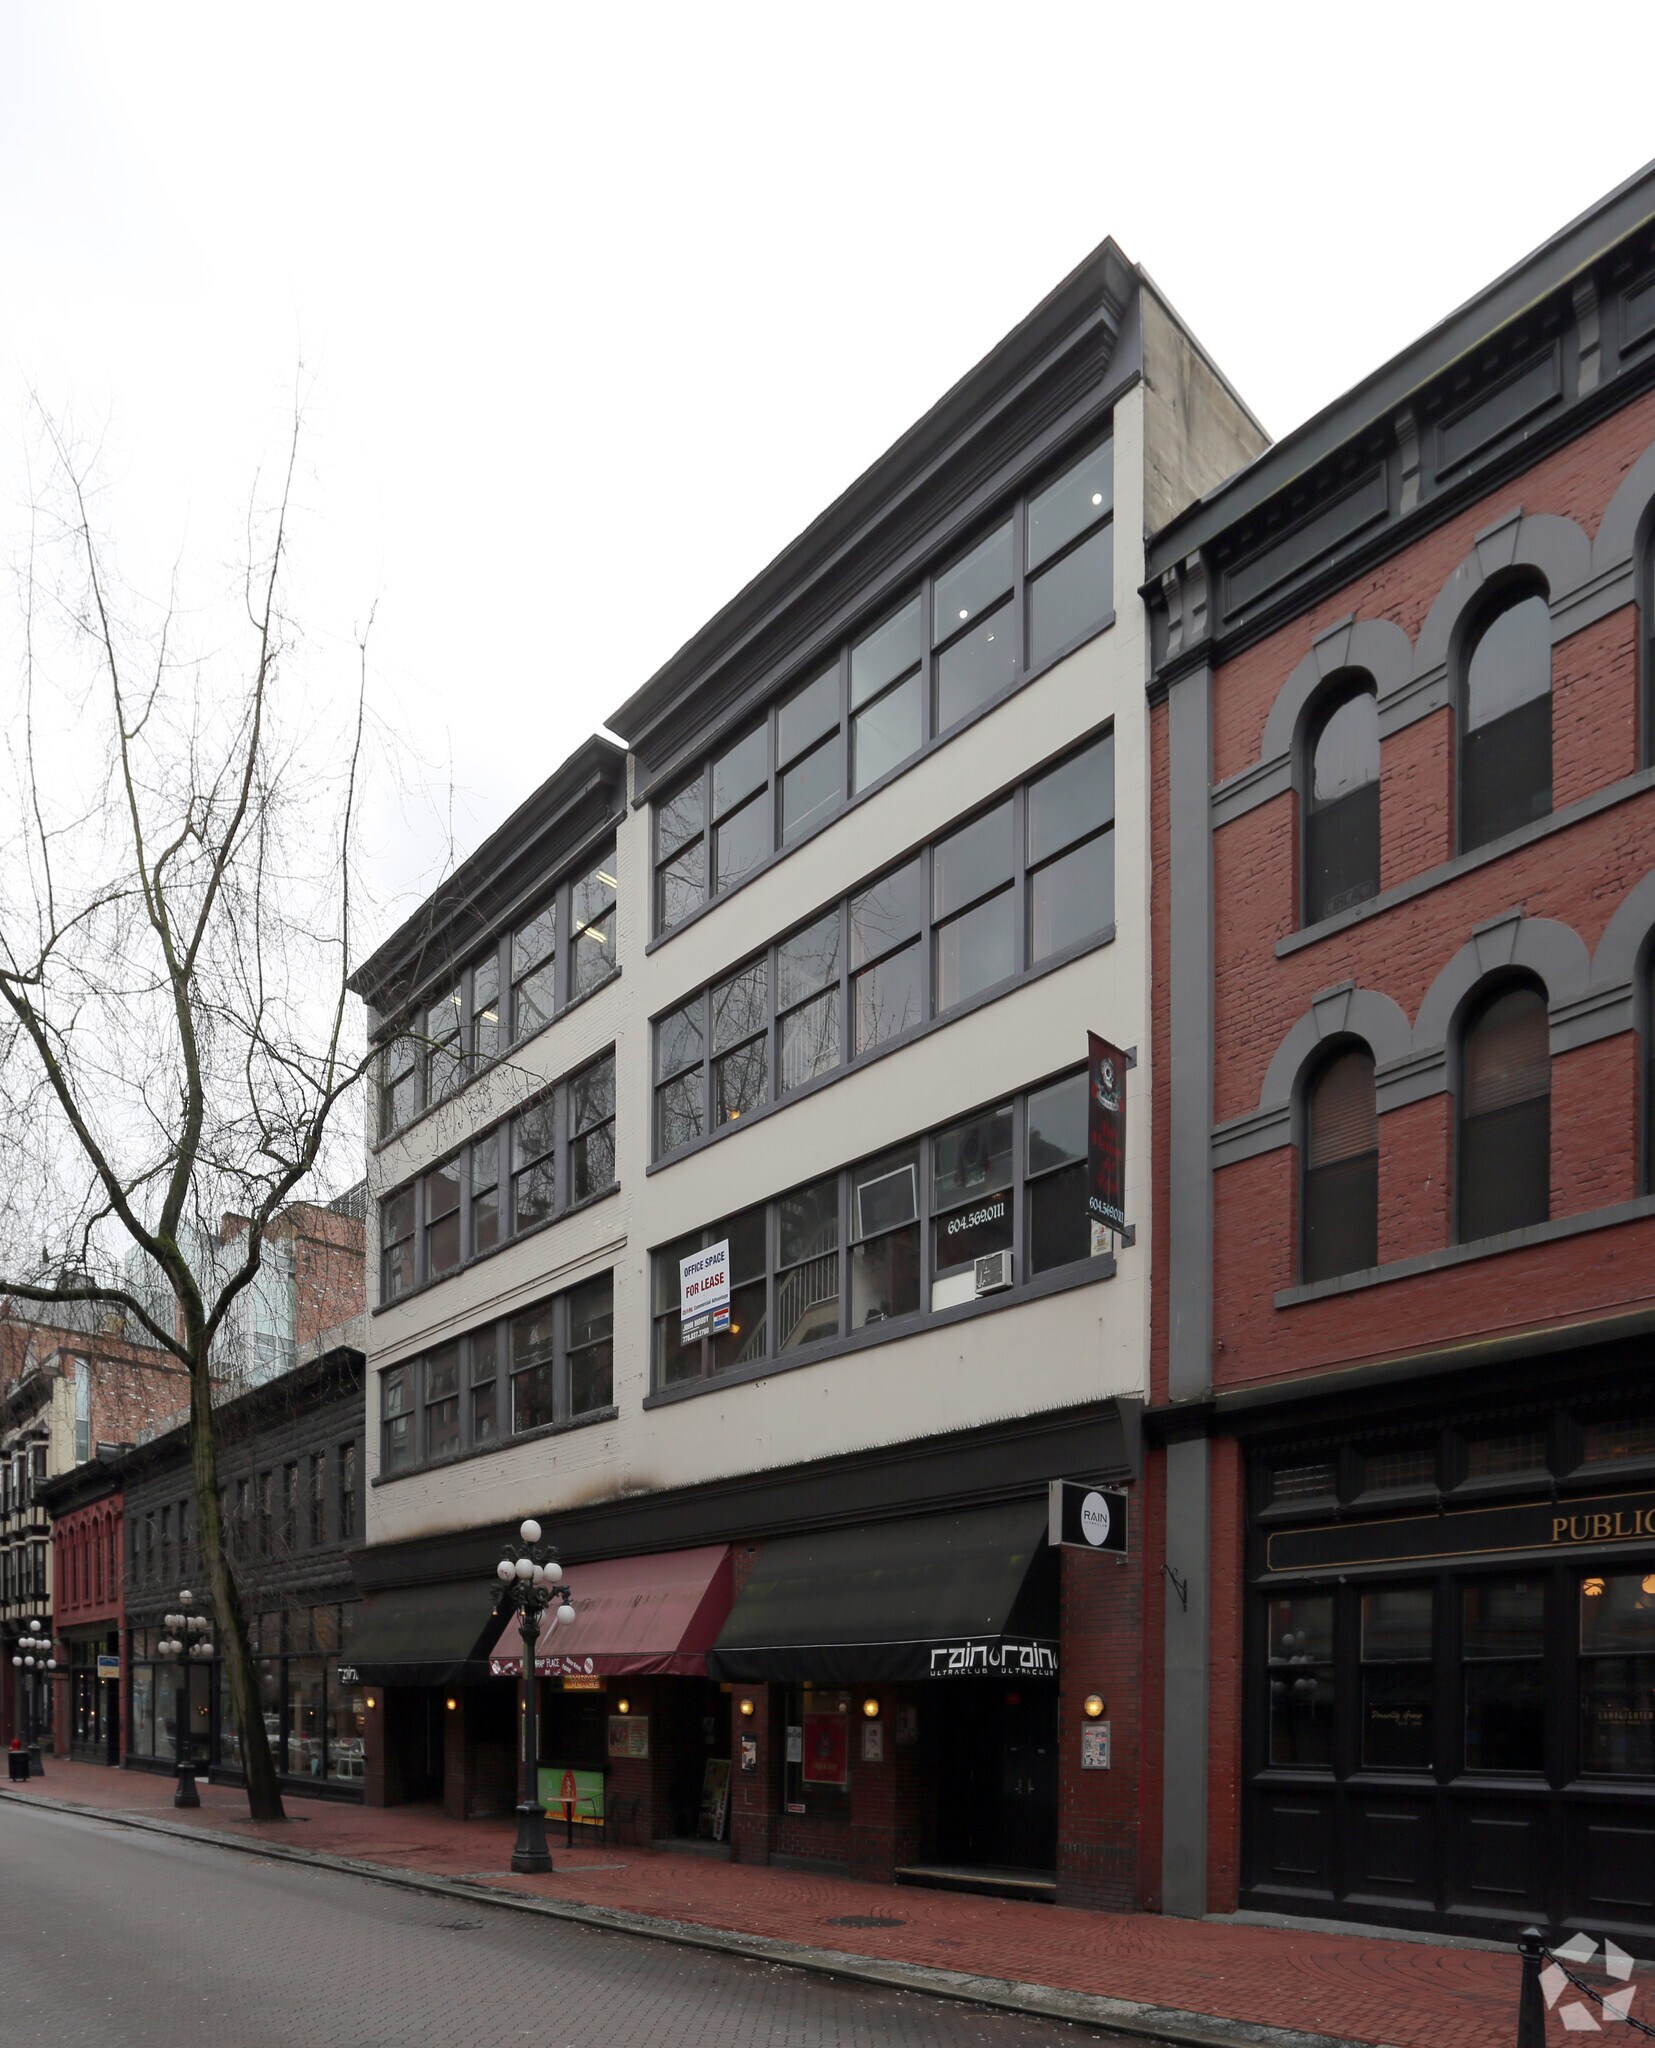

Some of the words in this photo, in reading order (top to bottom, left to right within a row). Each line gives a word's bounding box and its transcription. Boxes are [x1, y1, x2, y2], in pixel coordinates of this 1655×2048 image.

[947, 1202, 1005, 1235] 604.569.0111
[684, 1261, 704, 1277] OFFICE
[705, 1251, 725, 1268] SPACE
[685, 1282, 699, 1299] FOR
[701, 1272, 724, 1291] LEASE
[1083, 1510, 1108, 1523] RAIN
[930, 1641, 988, 1669] rain
[1001, 1641, 1054, 1669] rain
[570, 1680, 600, 1688] PLACE
[930, 1668, 988, 1676] ULTRACLUB
[1001, 1668, 1054, 1676] ULTRACLUB
